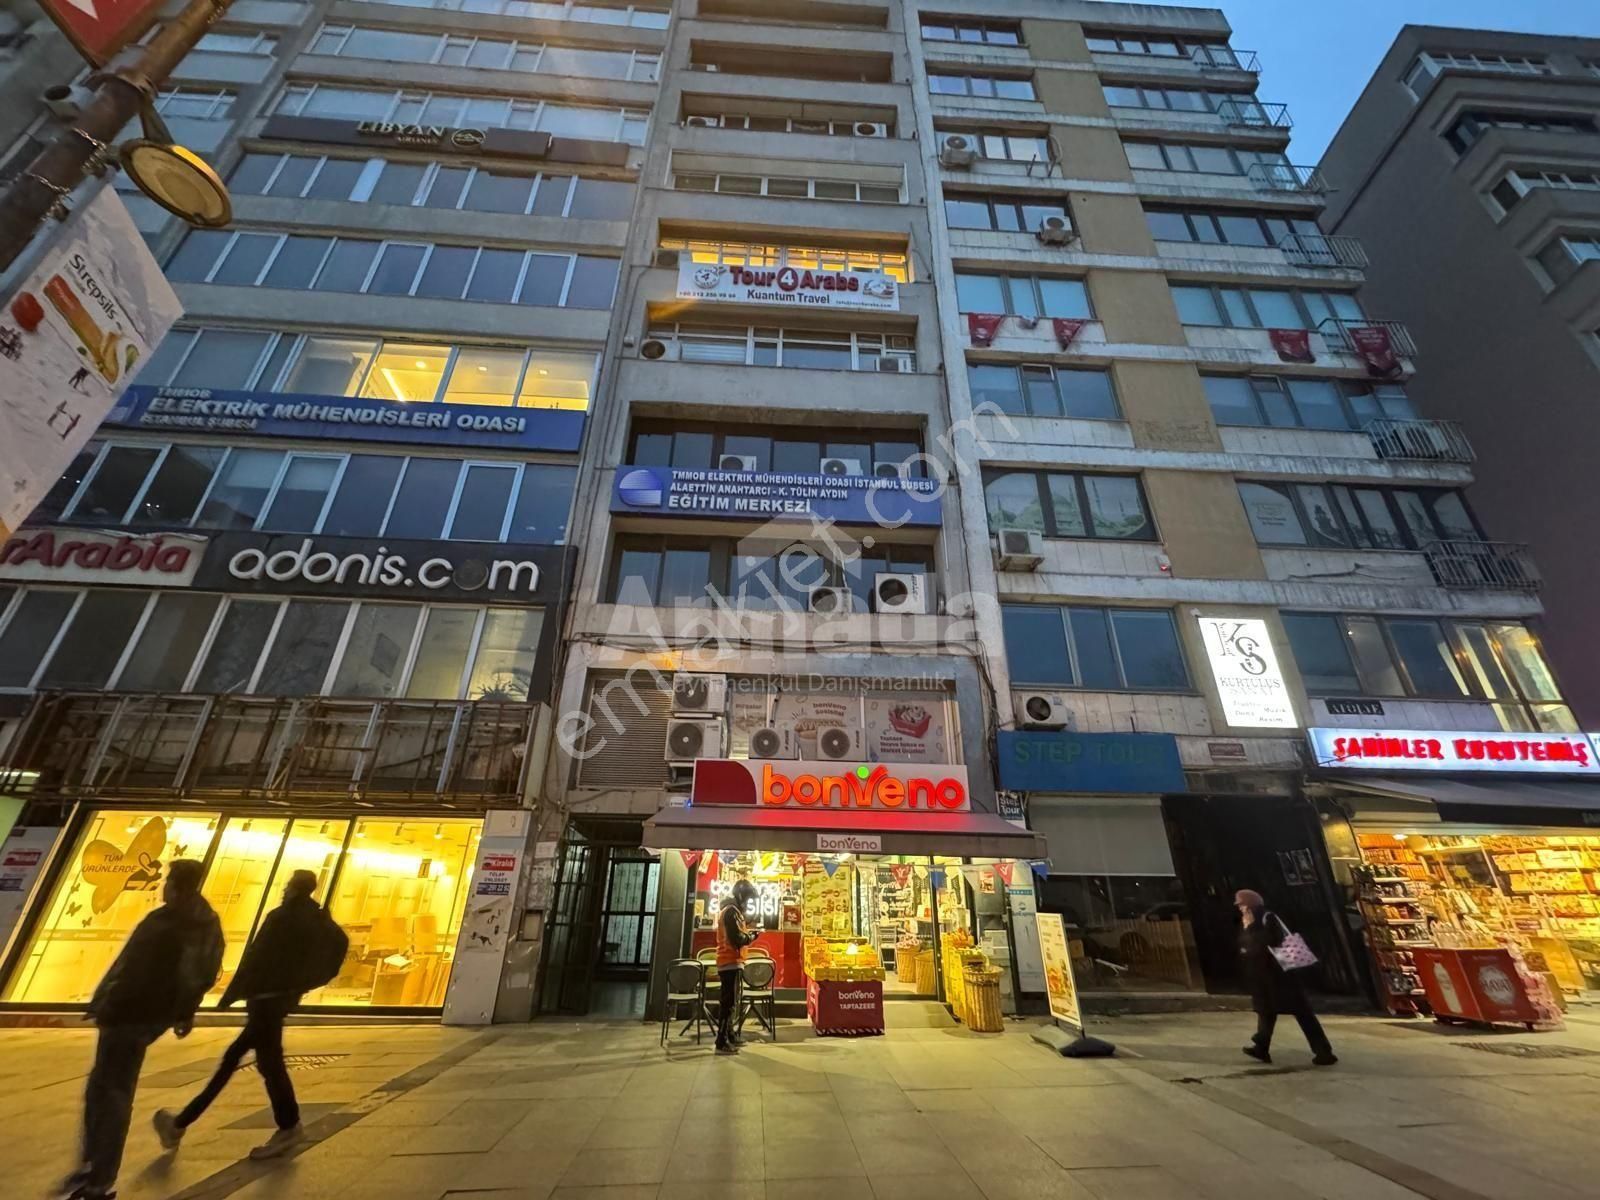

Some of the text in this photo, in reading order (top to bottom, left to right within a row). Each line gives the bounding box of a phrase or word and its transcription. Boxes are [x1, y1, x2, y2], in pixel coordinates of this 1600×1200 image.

[356, 120, 445, 137] LIBYAN
[68, 253, 118, 320] Strepsils
[729, 265, 775, 287] Tour
[799, 270, 859, 292] Arabs
[746, 289, 830, 304] Kuantum Travel
[147, 397, 526, 433] ELEKTRİK MÜHENDİSLERİ ODASI
[671, 470, 705, 480] TMMOB
[825, 476, 852, 487] ODASI
[854, 477, 899, 490] İSTANBUL
[670, 482, 716, 493] ALAETTİN
[718, 484, 771, 495] ANAHTARCI
[778, 486, 788, 496] K.
[790, 487, 818, 498] TÜLİN
[820, 488, 848, 499] AYDIN
[668, 494, 811, 513] EĞİTİM MERKEZİ
[1014, 740, 1082, 763] STEP
[103, 853, 124, 862] TÜM
[82, 863, 139, 873] ÜRÜNLERDE
